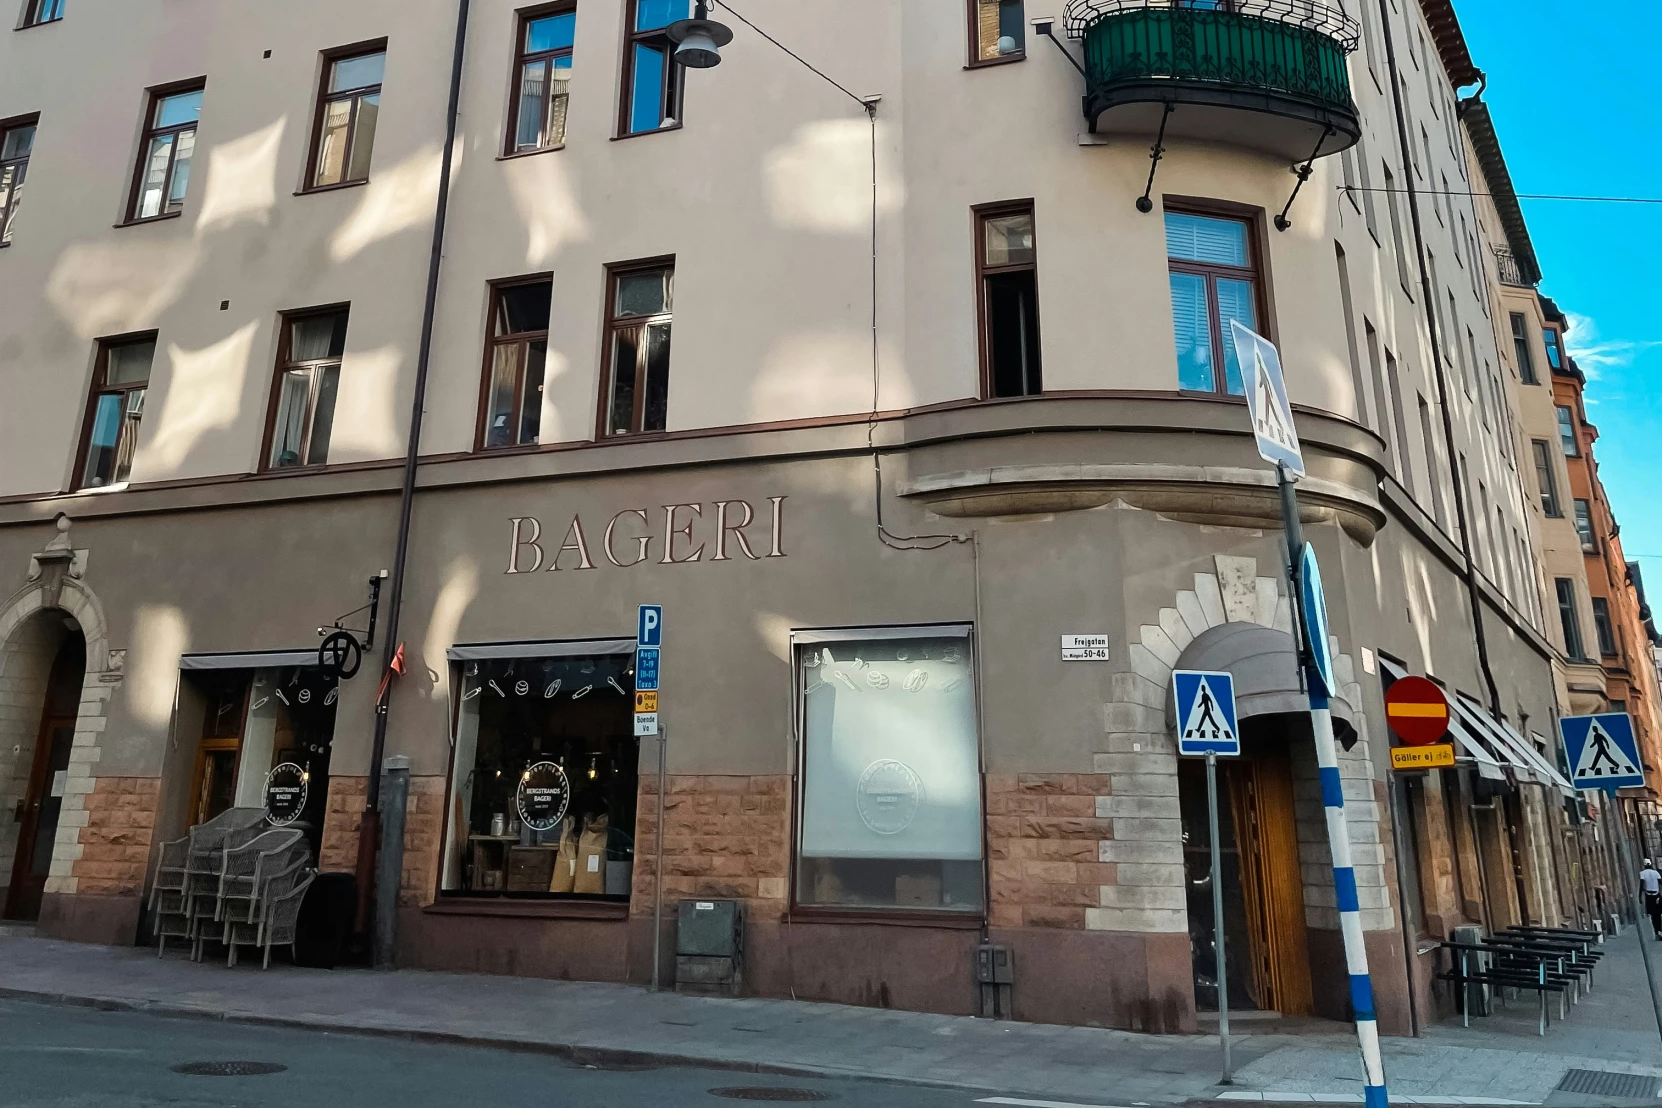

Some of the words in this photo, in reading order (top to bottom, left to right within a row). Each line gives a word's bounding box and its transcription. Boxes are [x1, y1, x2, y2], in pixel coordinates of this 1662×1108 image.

[503, 496, 789, 575] BAGERI
[644, 609, 658, 642] P
[1074, 638, 1105, 646] Frejgatan
[640, 650, 657, 660] Avgift
[643, 660, 654, 668] 7-19
[638, 680, 652, 688] Taxa
[653, 680, 657, 688] 3
[1394, 753, 1421, 762] Gäller
[1424, 752, 1433, 761] ej
